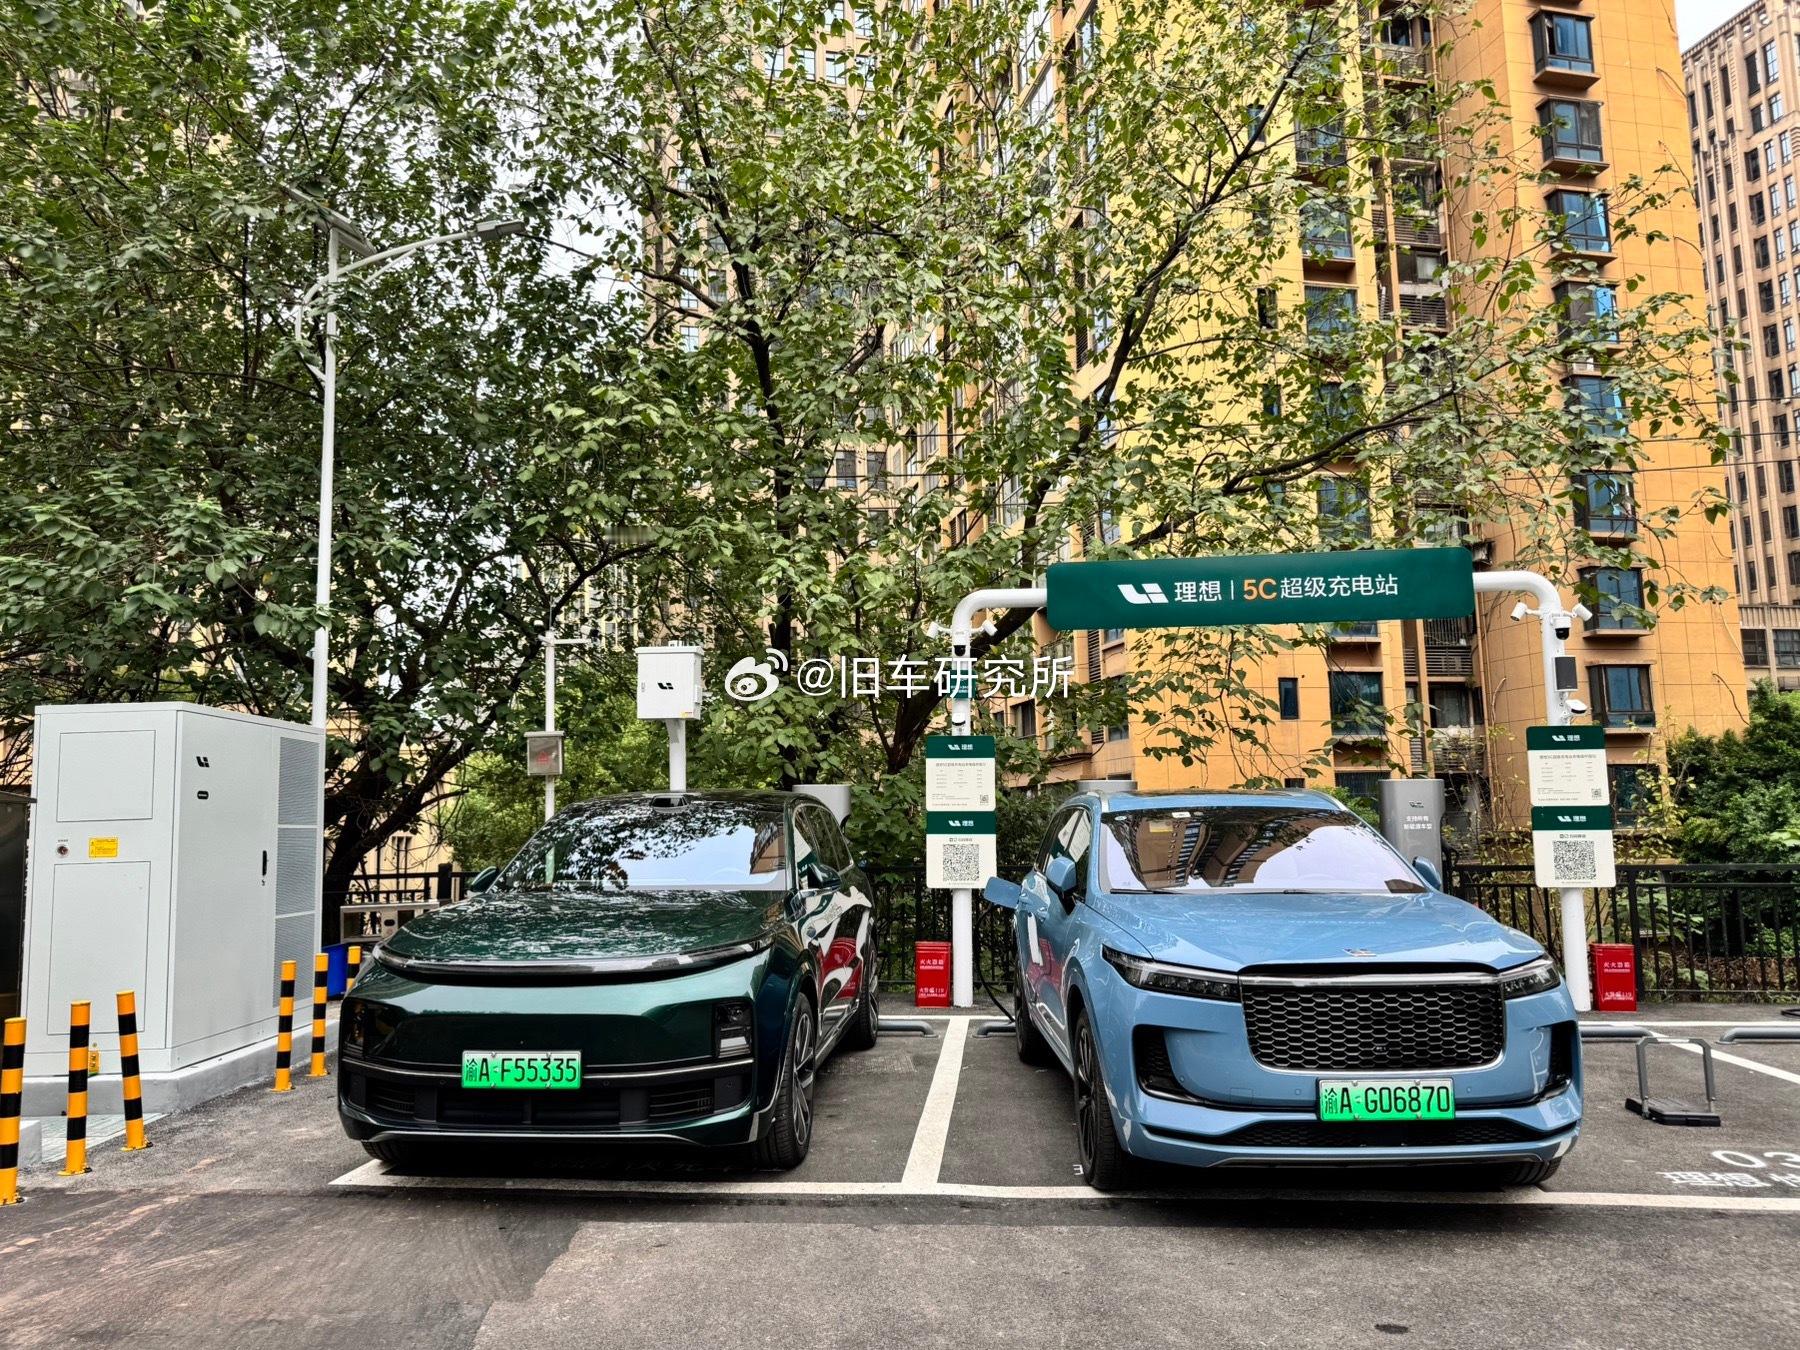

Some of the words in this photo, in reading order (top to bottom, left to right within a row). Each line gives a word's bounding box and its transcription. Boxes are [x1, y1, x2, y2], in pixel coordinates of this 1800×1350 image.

[1174, 580, 1222, 603] 理想
[1243, 573, 1399, 601] 5C超级充电站
